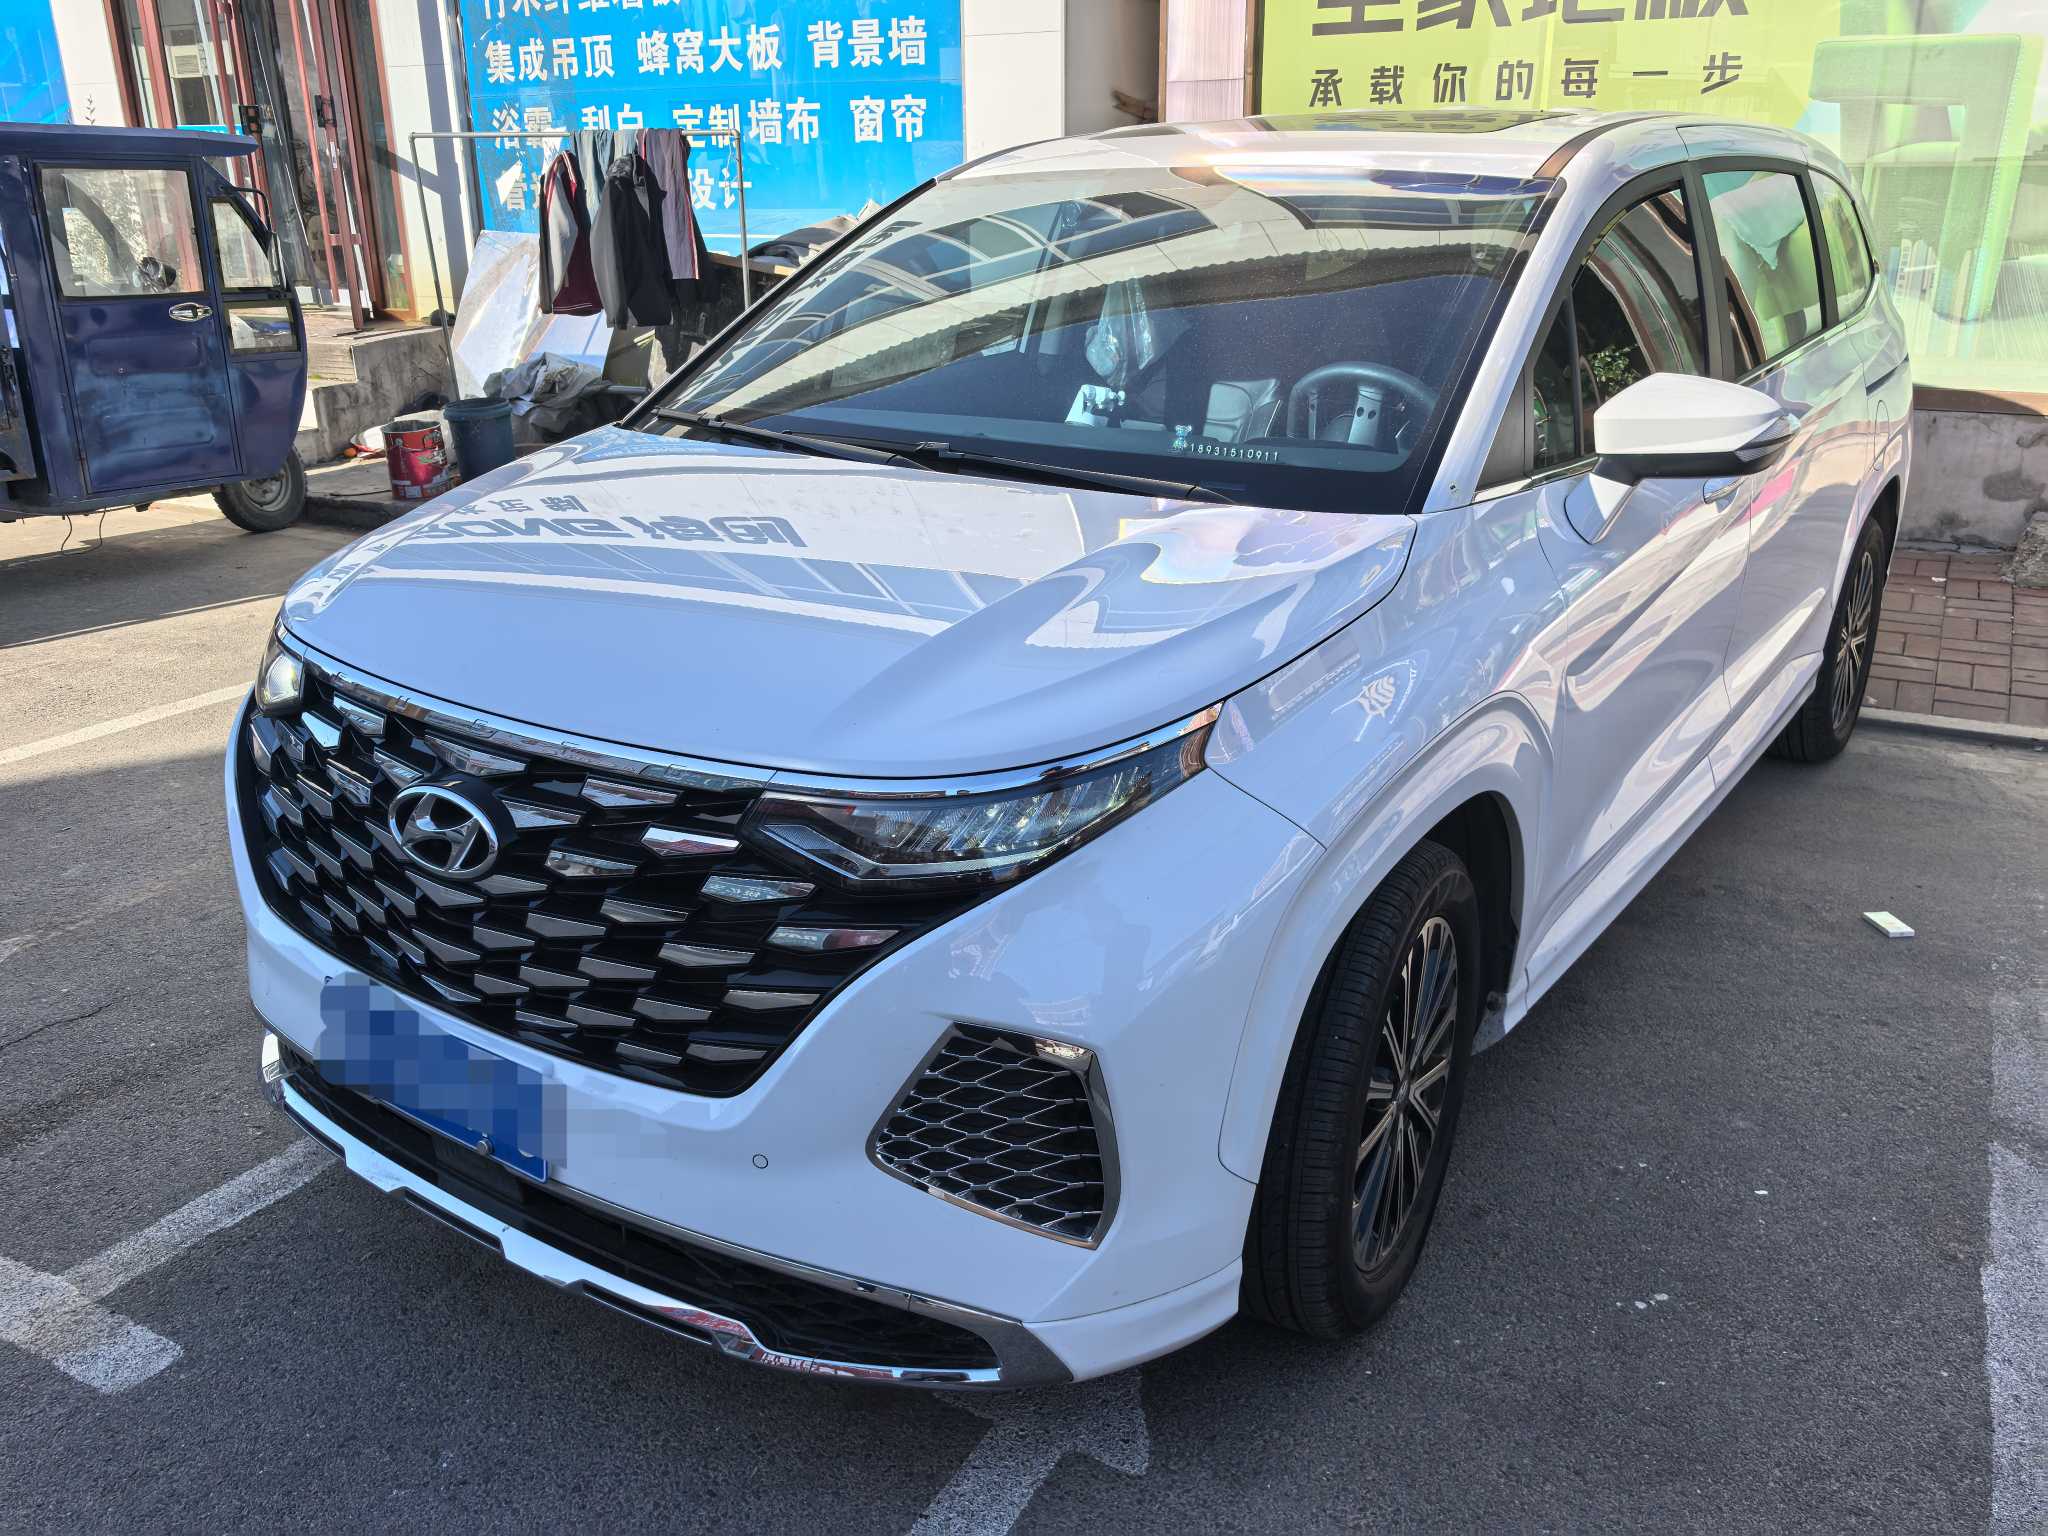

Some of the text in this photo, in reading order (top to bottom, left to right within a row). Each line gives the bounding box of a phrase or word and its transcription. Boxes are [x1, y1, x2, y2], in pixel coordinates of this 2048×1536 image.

[485, 15, 928, 84] 集成吊顶 蜂窝大板 背景墙
[1308, 51, 1745, 108] 承载你的每一步
[849, 94, 927, 143] 窗帘
[1190, 442, 1279, 461] 18931510911
